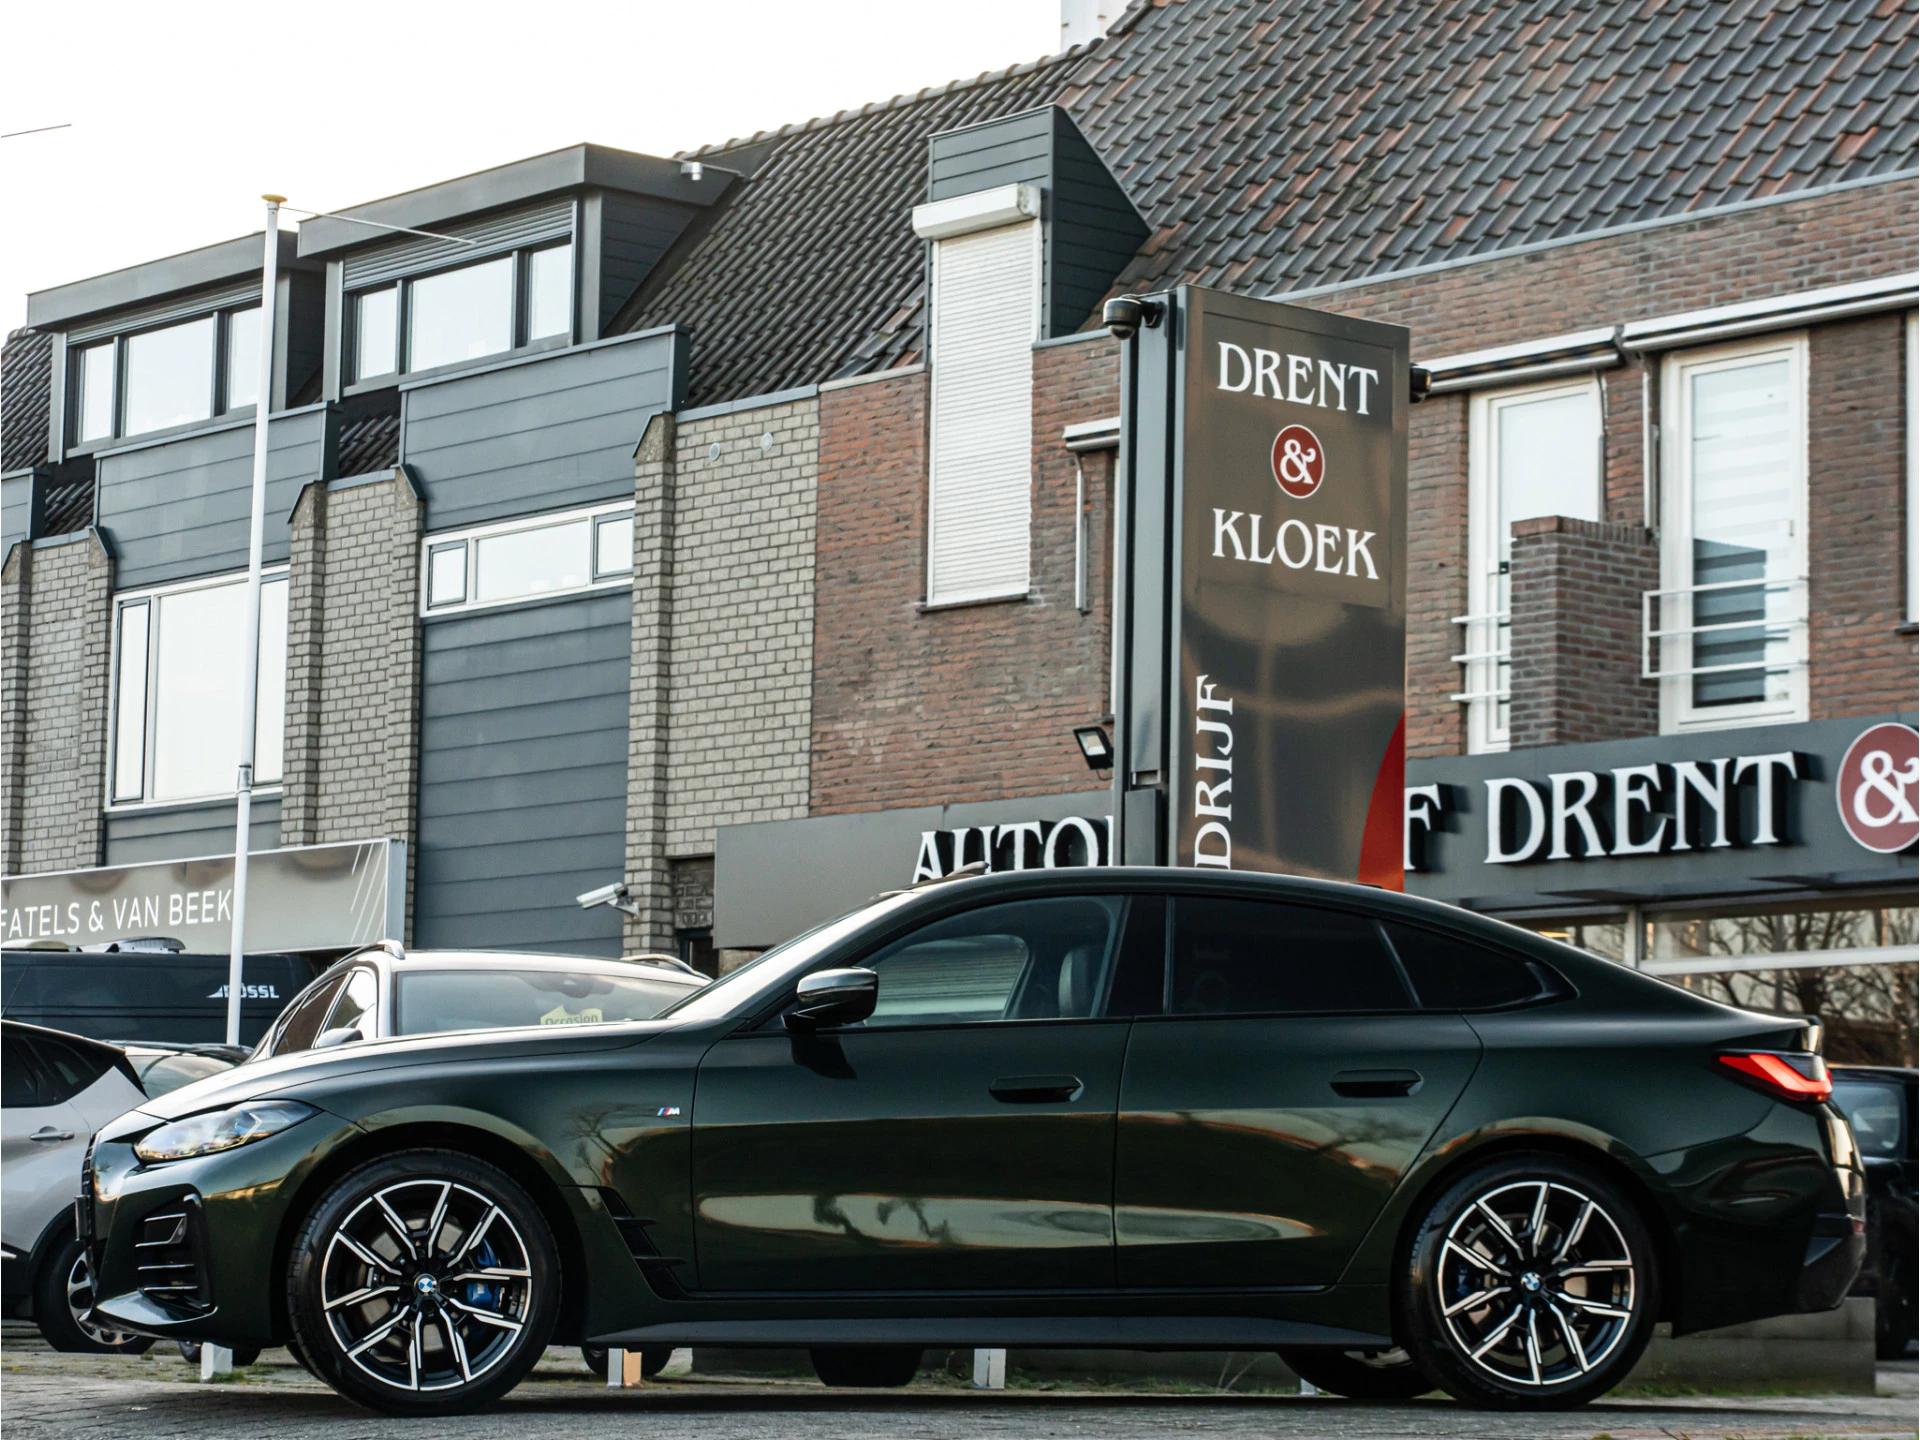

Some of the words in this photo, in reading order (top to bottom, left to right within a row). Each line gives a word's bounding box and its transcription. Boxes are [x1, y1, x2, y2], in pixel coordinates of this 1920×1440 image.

[1217, 341, 1379, 415] DRENT
[1280, 439, 1316, 484] &
[1212, 508, 1380, 580] KLOEK
[912, 815, 1113, 883] AUTO
[1484, 752, 1797, 863] DRENT
[1853, 750, 1919, 827] &
[88, 900, 103, 932] &
[113, 895, 159, 930] VAN
[169, 889, 232, 925] BEEK
